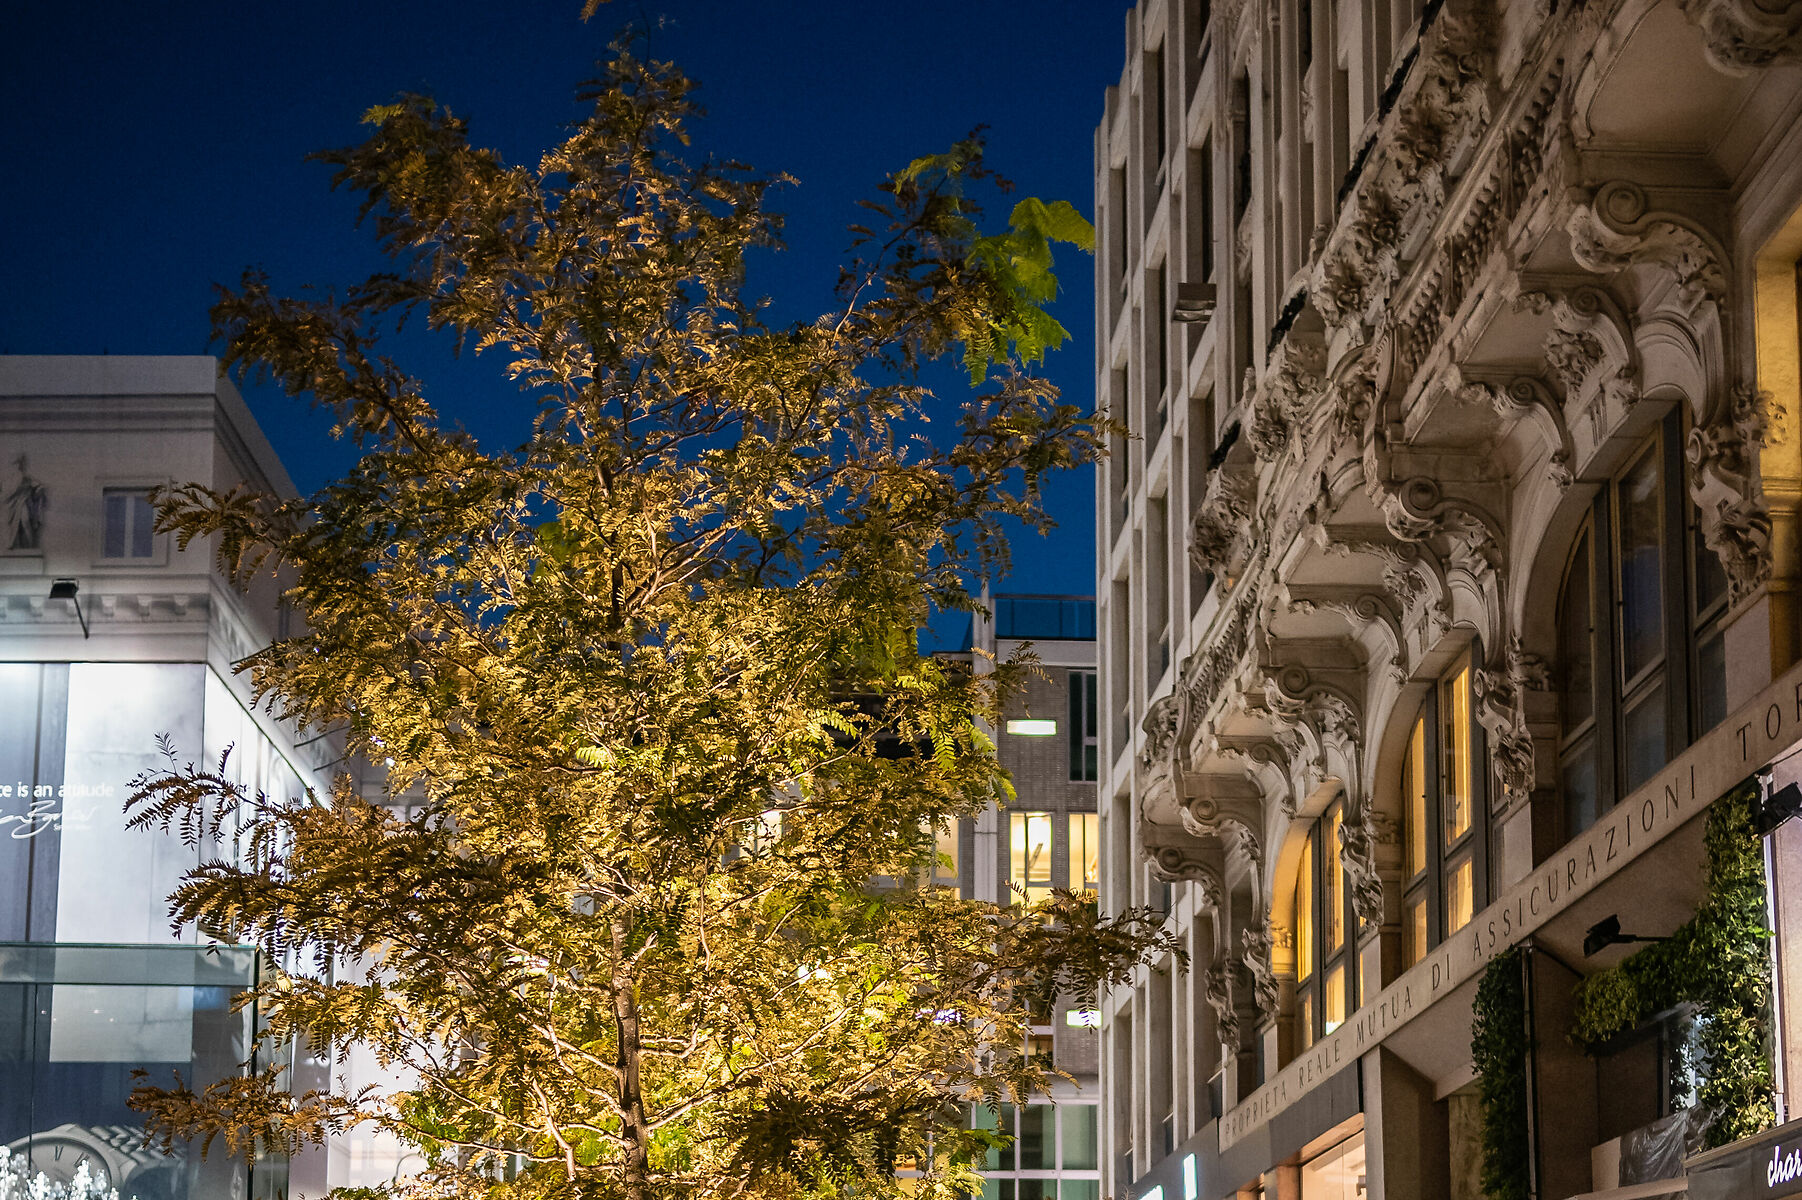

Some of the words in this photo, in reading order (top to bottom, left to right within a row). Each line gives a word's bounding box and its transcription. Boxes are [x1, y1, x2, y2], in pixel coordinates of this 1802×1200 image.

[17, 781, 29, 798] is
[33, 784, 53, 798] an
[1298, 1038, 1341, 1089] REALE
[1355, 985, 1413, 1048] MUTUA
[1431, 953, 1451, 992] DI
[1472, 764, 1696, 961] ASSICURAZIONI
